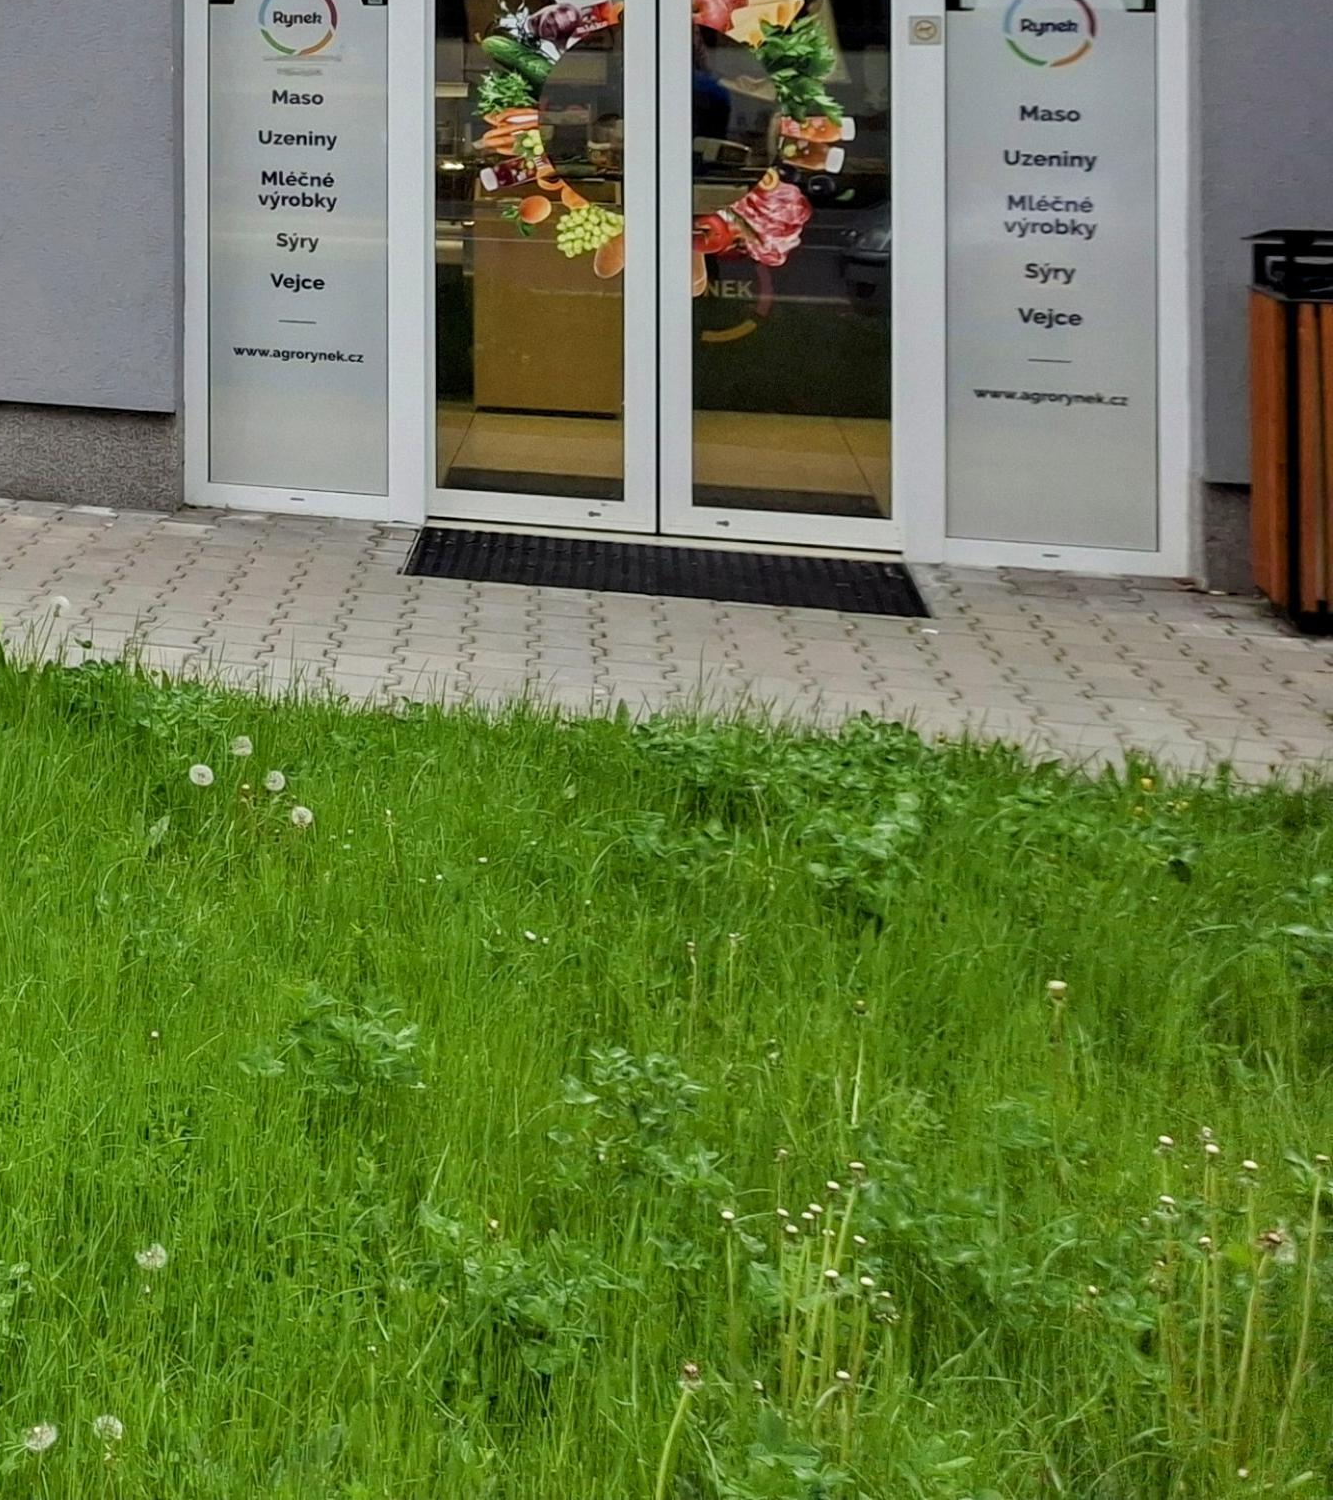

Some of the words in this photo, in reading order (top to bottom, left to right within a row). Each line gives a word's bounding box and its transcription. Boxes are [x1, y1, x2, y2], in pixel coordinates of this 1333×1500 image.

[273, 11, 323, 28] Rynek
[1020, 18, 1079, 37] Rynek
[272, 89, 324, 106] Maso
[1019, 105, 1081, 123] Maso
[258, 130, 337, 150] Uzeniny
[1003, 150, 1097, 172] Uzeniny
[261, 170, 335, 187] Mléčné
[258, 190, 337, 212] výrobky
[1007, 194, 1093, 213] Mléčné
[1004, 217, 1097, 240] výrobky
[276, 232, 319, 252] Sýry
[270, 273, 325, 293] Vejce
[1024, 263, 1076, 284] Sýry
[1018, 307, 1084, 329] Vejce
[233, 346, 364, 363] www.agrorynek.cz
[973, 388, 1129, 407] www.agrorynek.cz
